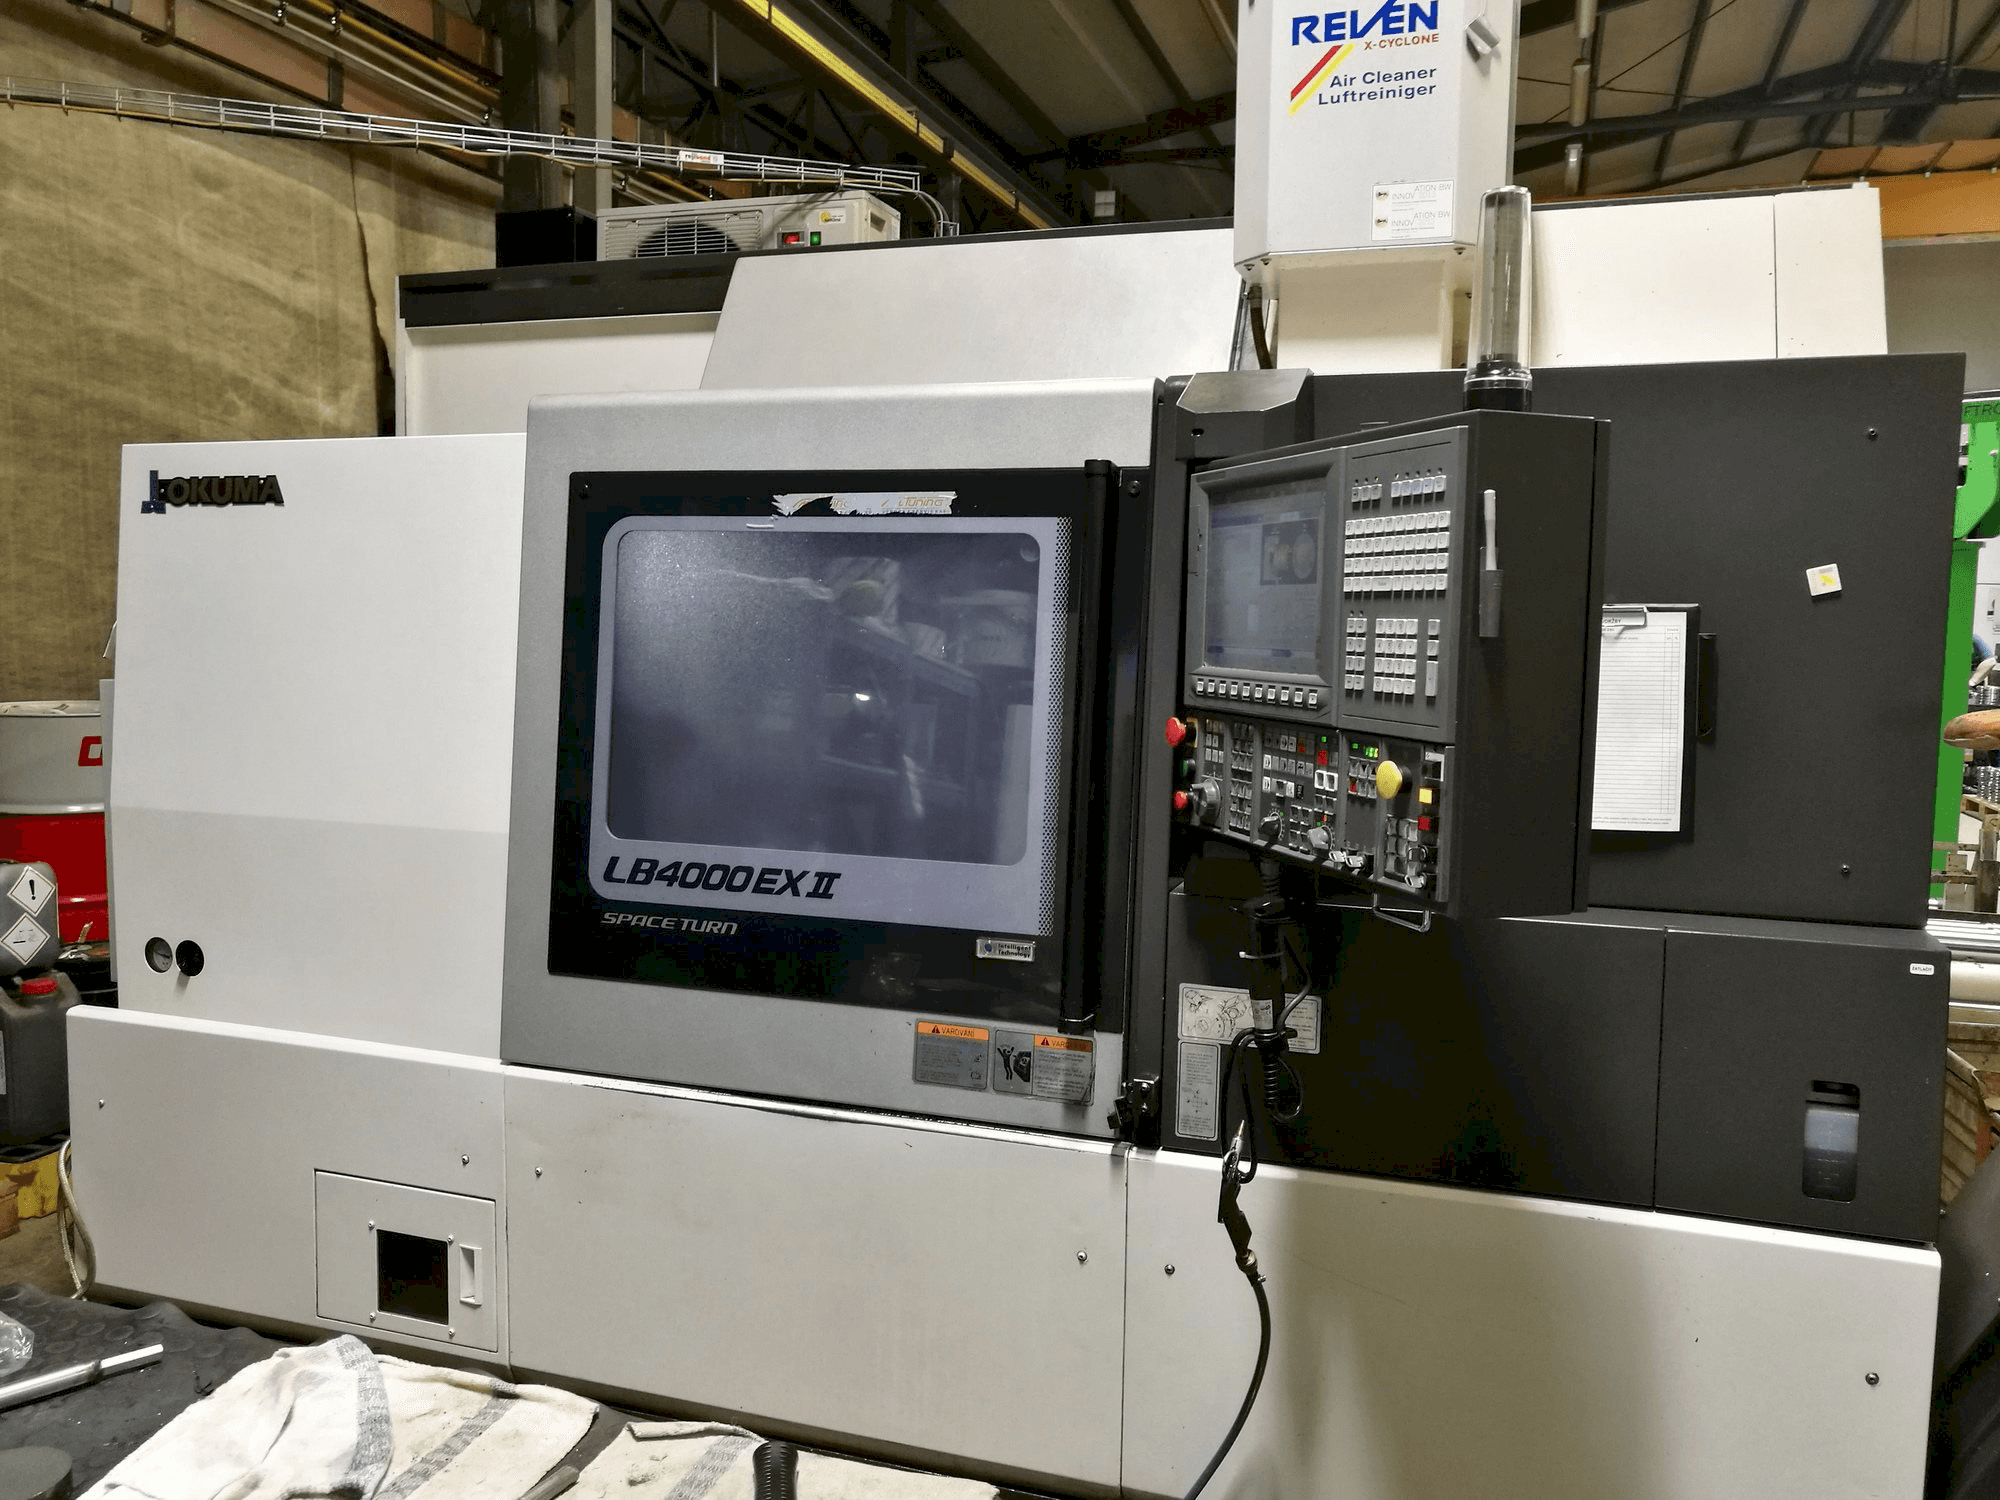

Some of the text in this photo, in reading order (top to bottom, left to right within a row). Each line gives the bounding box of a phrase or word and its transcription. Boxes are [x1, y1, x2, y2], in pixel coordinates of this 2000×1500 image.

[1292, 0, 1438, 46] REVEN
[1364, 33, 1439, 50] X-CYCLONE
[1330, 68, 1438, 88] Air Cleaner
[1318, 84, 1437, 105] Luftreiniger
[167, 475, 284, 507] OKUMA
[997, 943, 1031, 951] Intelligent
[998, 949, 1031, 958] Technology
